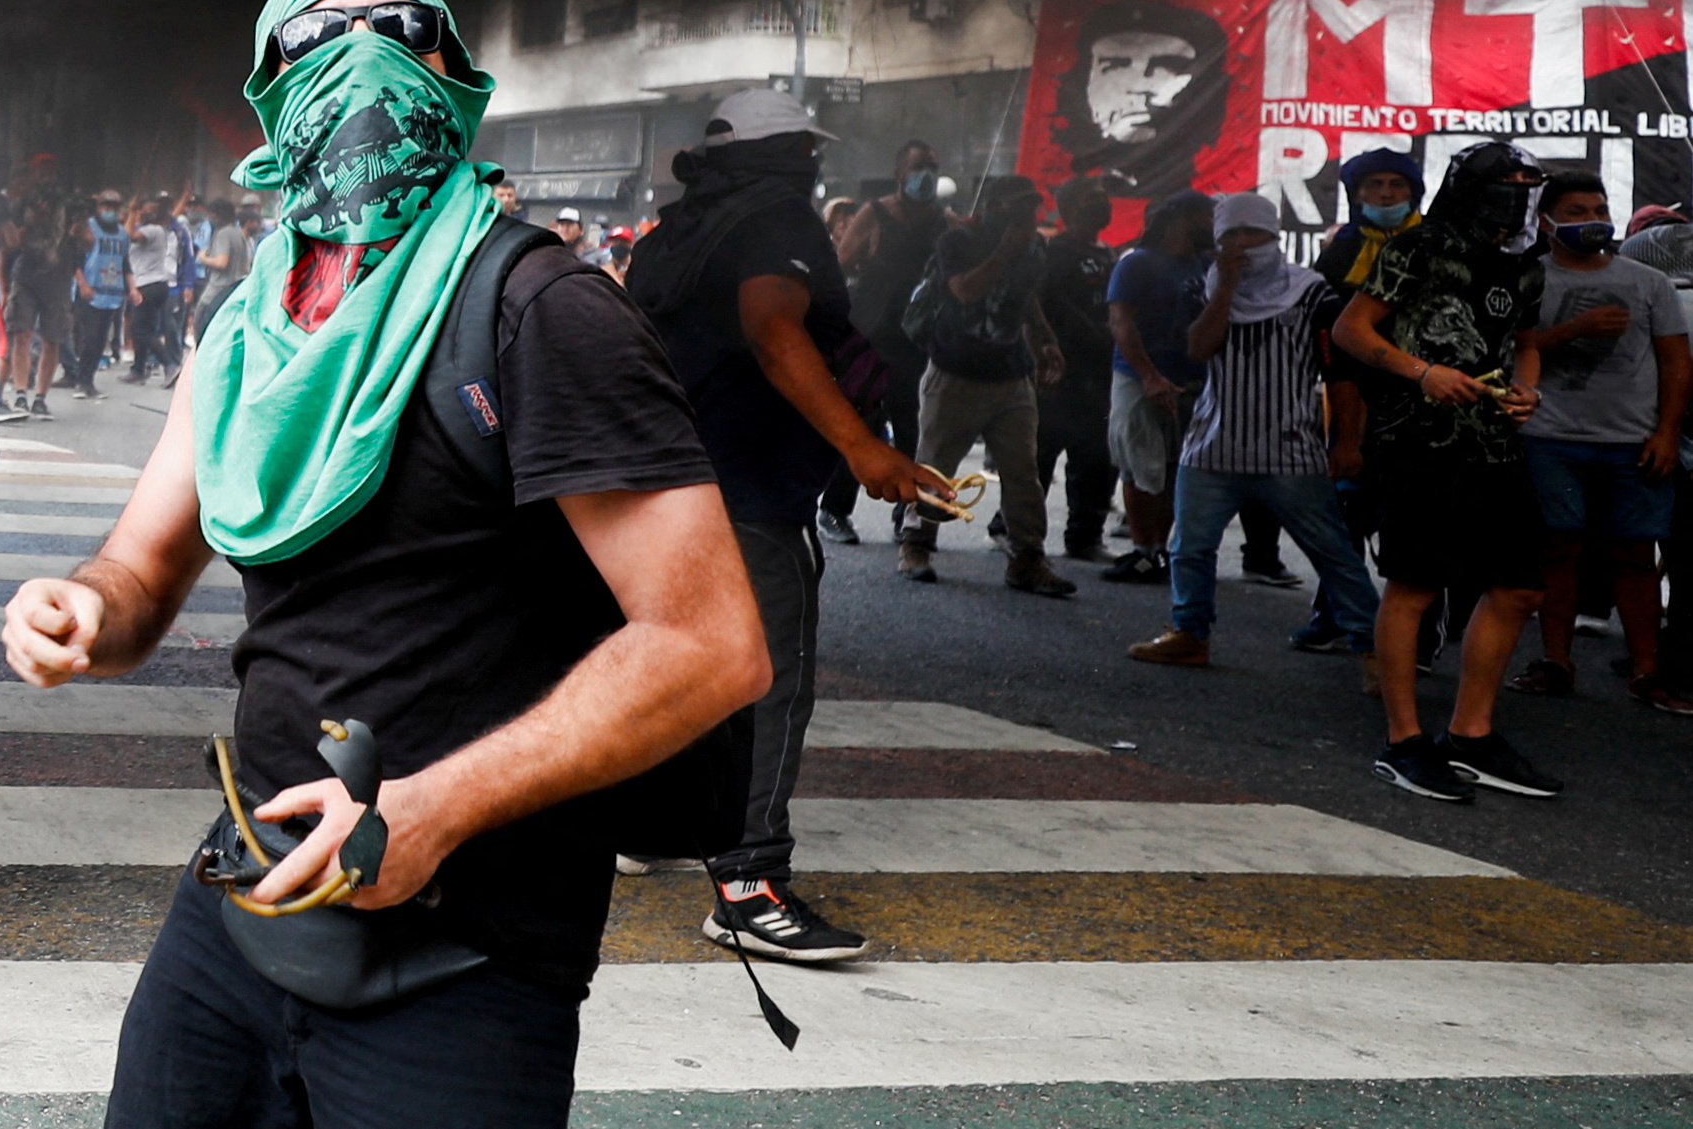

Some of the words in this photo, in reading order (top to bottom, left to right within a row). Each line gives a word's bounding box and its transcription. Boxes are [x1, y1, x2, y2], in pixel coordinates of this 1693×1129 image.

[1261, 101, 1417, 130] MOVIMIENTO
[1427, 108, 1621, 133] TERRITORIAL
[1637, 112, 1693, 138] LIB
